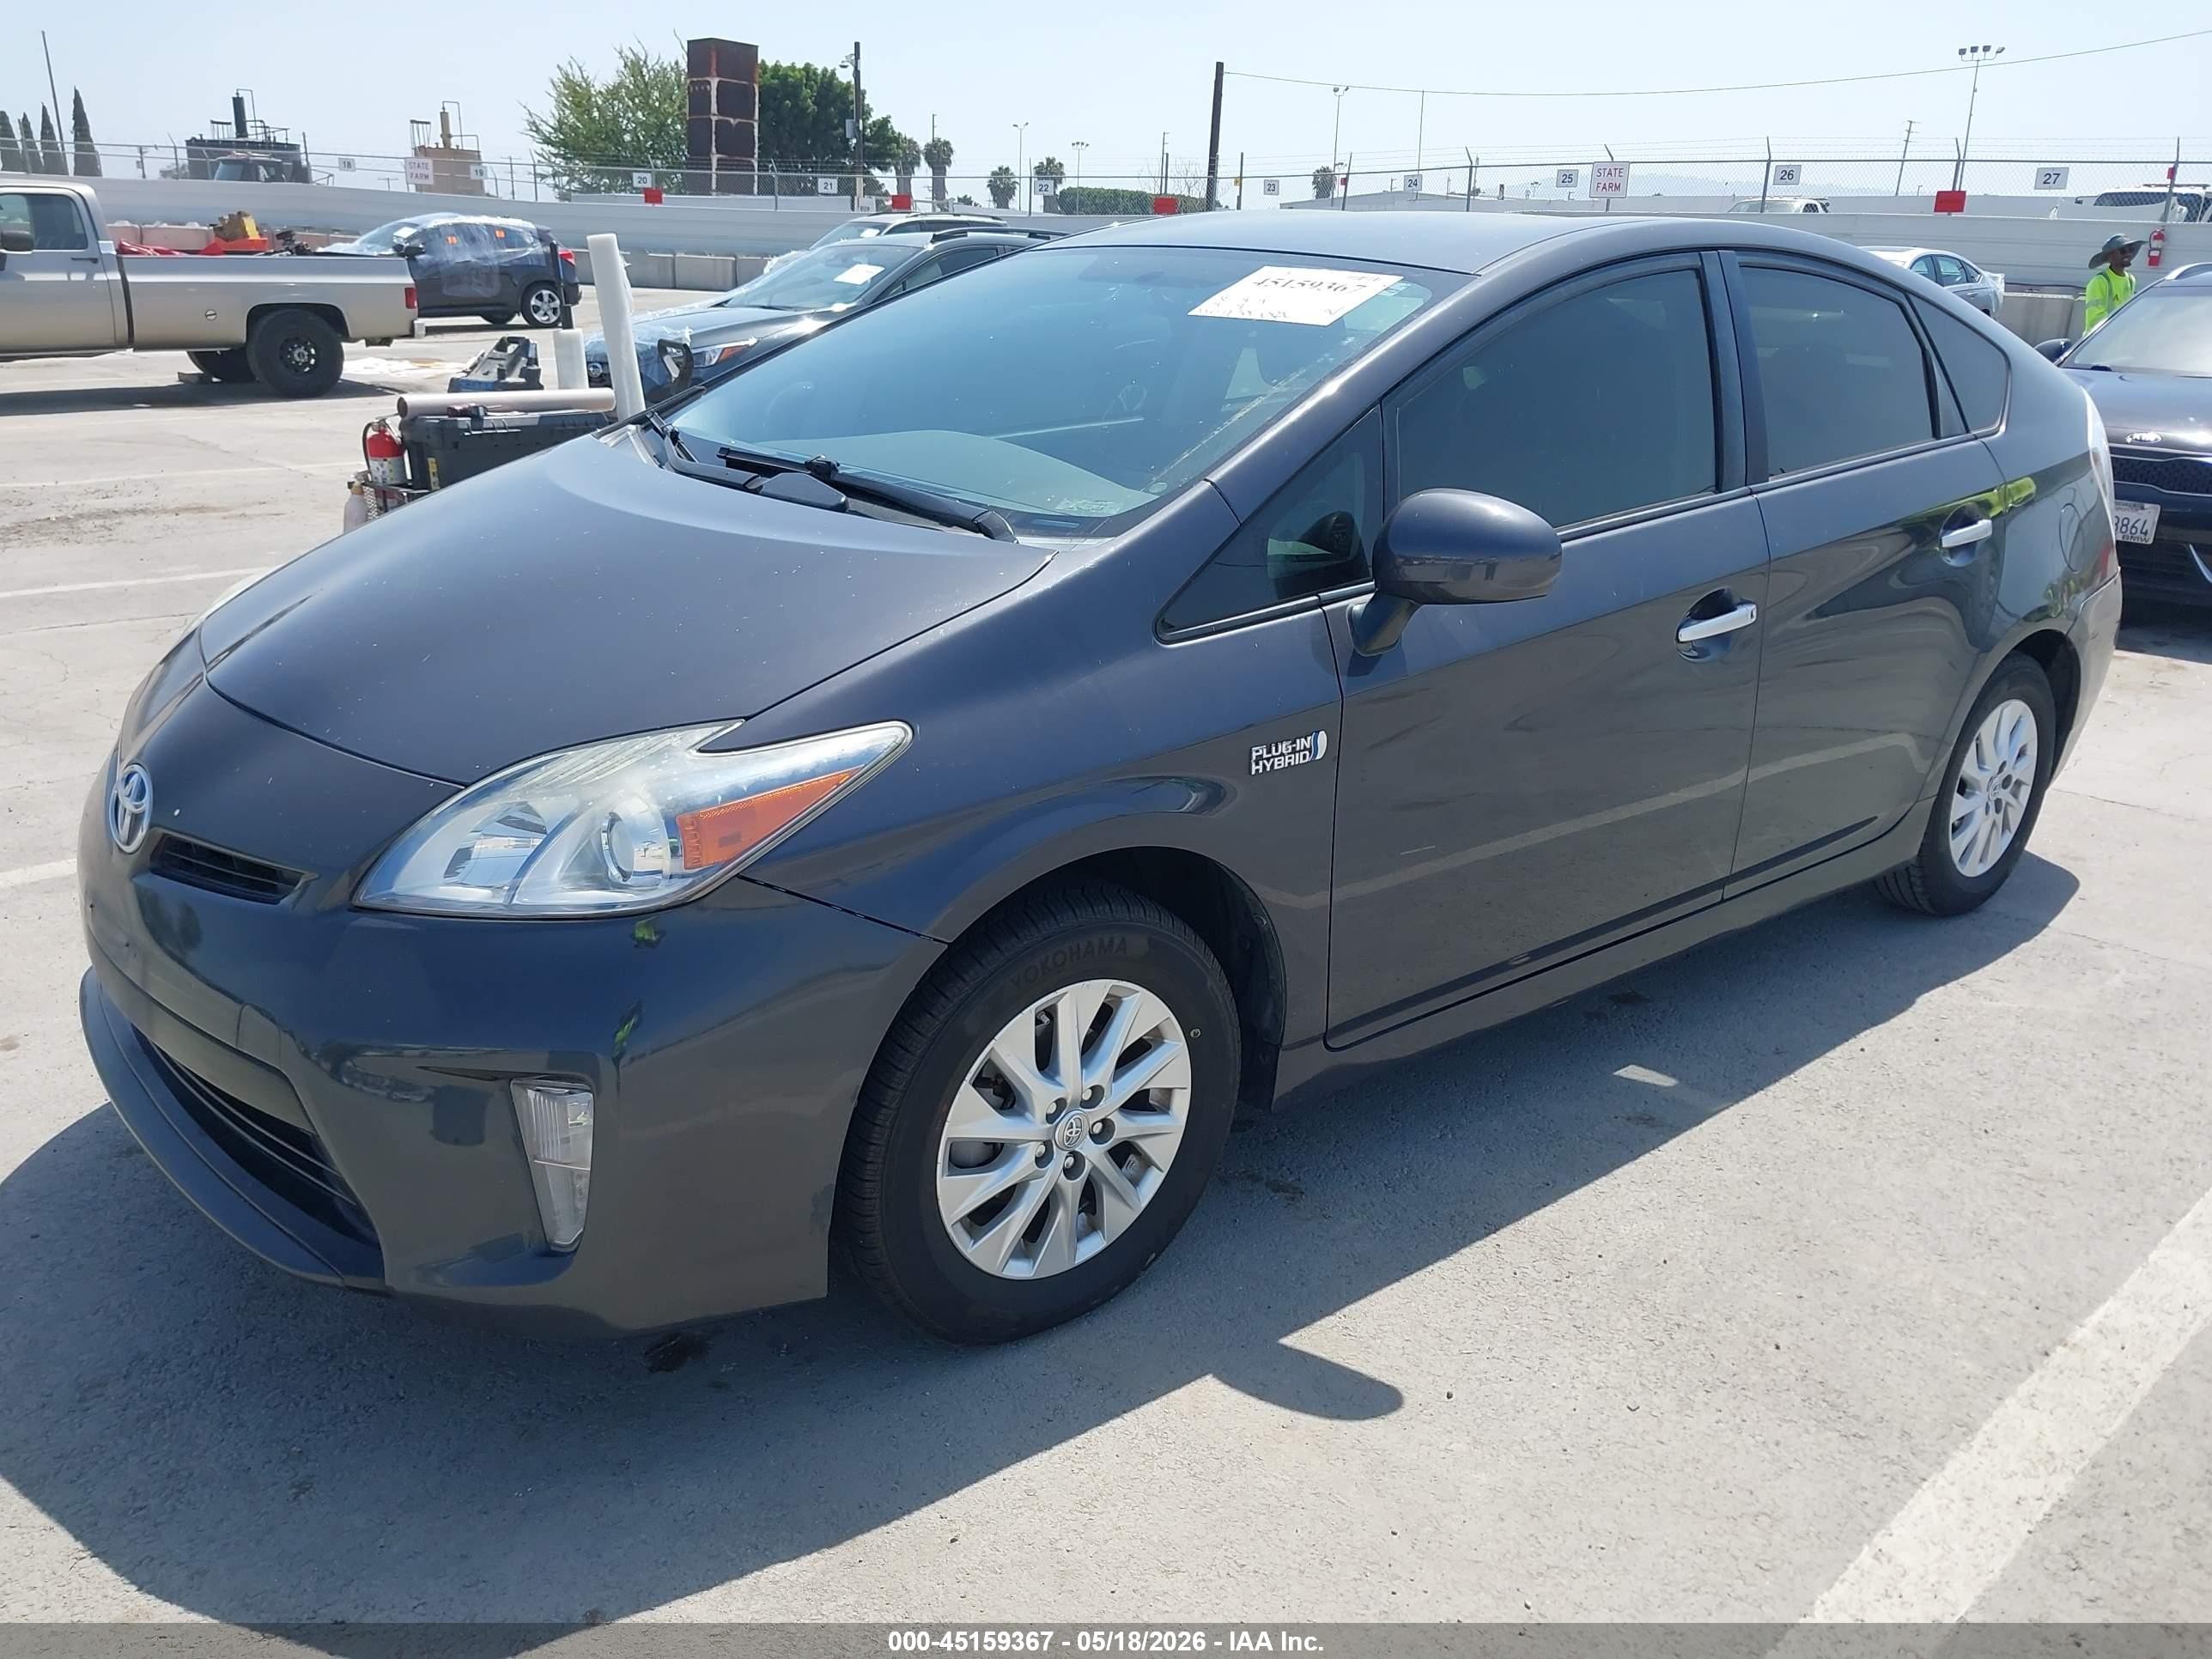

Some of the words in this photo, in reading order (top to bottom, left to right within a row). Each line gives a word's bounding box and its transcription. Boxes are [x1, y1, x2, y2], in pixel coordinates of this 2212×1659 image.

[409, 161, 428, 170] STATE
[1596, 167, 1624, 178] STATE
[1779, 169, 1795, 180] 26
[1407, 179, 1418, 187] 24
[1561, 173, 1573, 184] 25
[2042, 173, 2061, 185] 27
[823, 181, 833, 190] 21
[1038, 184, 1049, 192] 22
[1267, 183, 1276, 191] 23
[1595, 182, 1621, 192] FARM
[1251, 736, 1312, 761] PLUG-IN
[1251, 750, 1310, 775] HYBRID
[1011, 935, 1127, 988] YOKOHAMA
